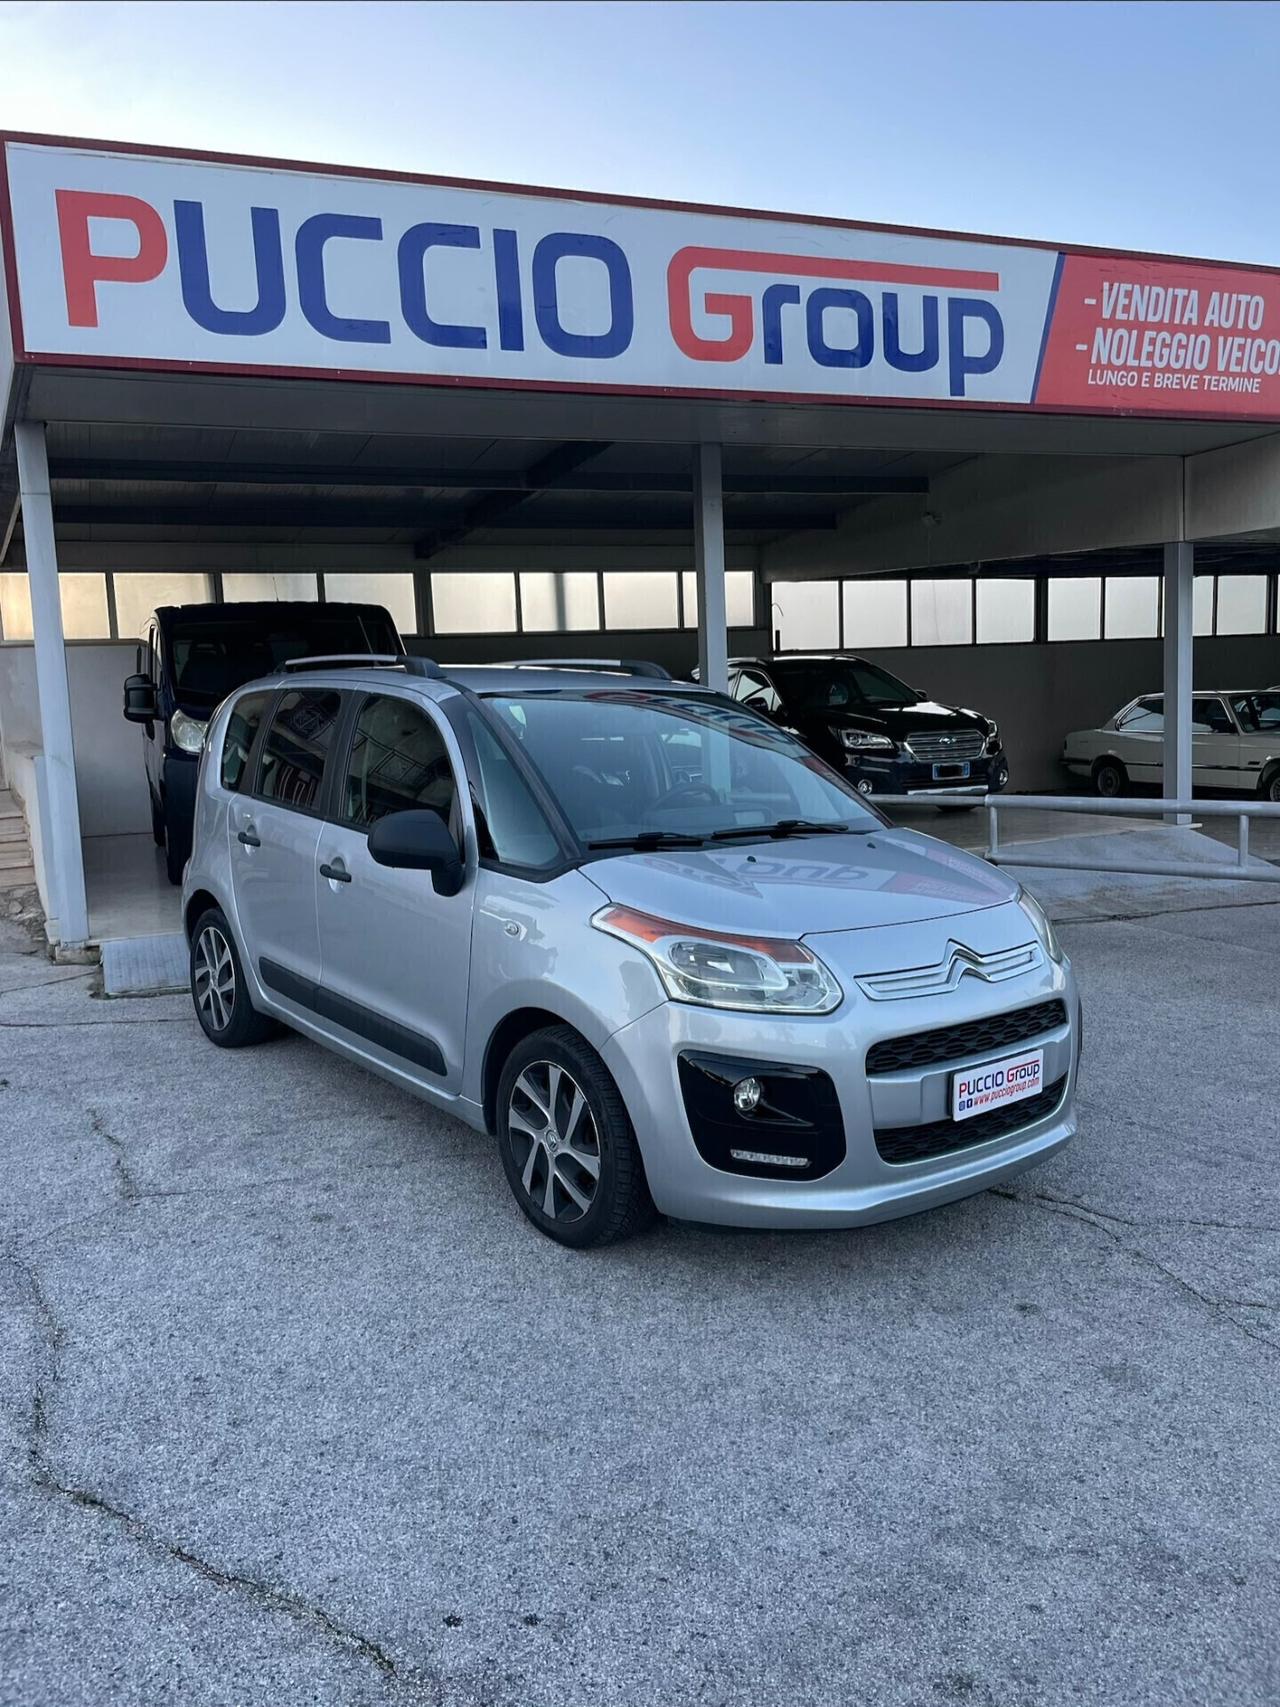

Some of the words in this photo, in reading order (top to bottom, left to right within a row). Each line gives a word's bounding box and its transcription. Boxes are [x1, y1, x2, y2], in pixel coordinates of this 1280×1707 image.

[55, 189, 634, 359] PUCCIO
[1102, 282, 1199, 326] VENDITA
[1204, 292, 1265, 331] AUTO
[1091, 327, 1211, 371] NOLEGGIO
[1217, 336, 1280, 376] VEICO
[1088, 369, 1138, 387] LUNGO
[1141, 373, 1151, 387] E
[1154, 374, 1200, 390] BREVE
[1203, 375, 1262, 394] TERMINE
[959, 1071, 1004, 1098] PUCCIO
[974, 1077, 1039, 1106] www.pucciogroup.com
